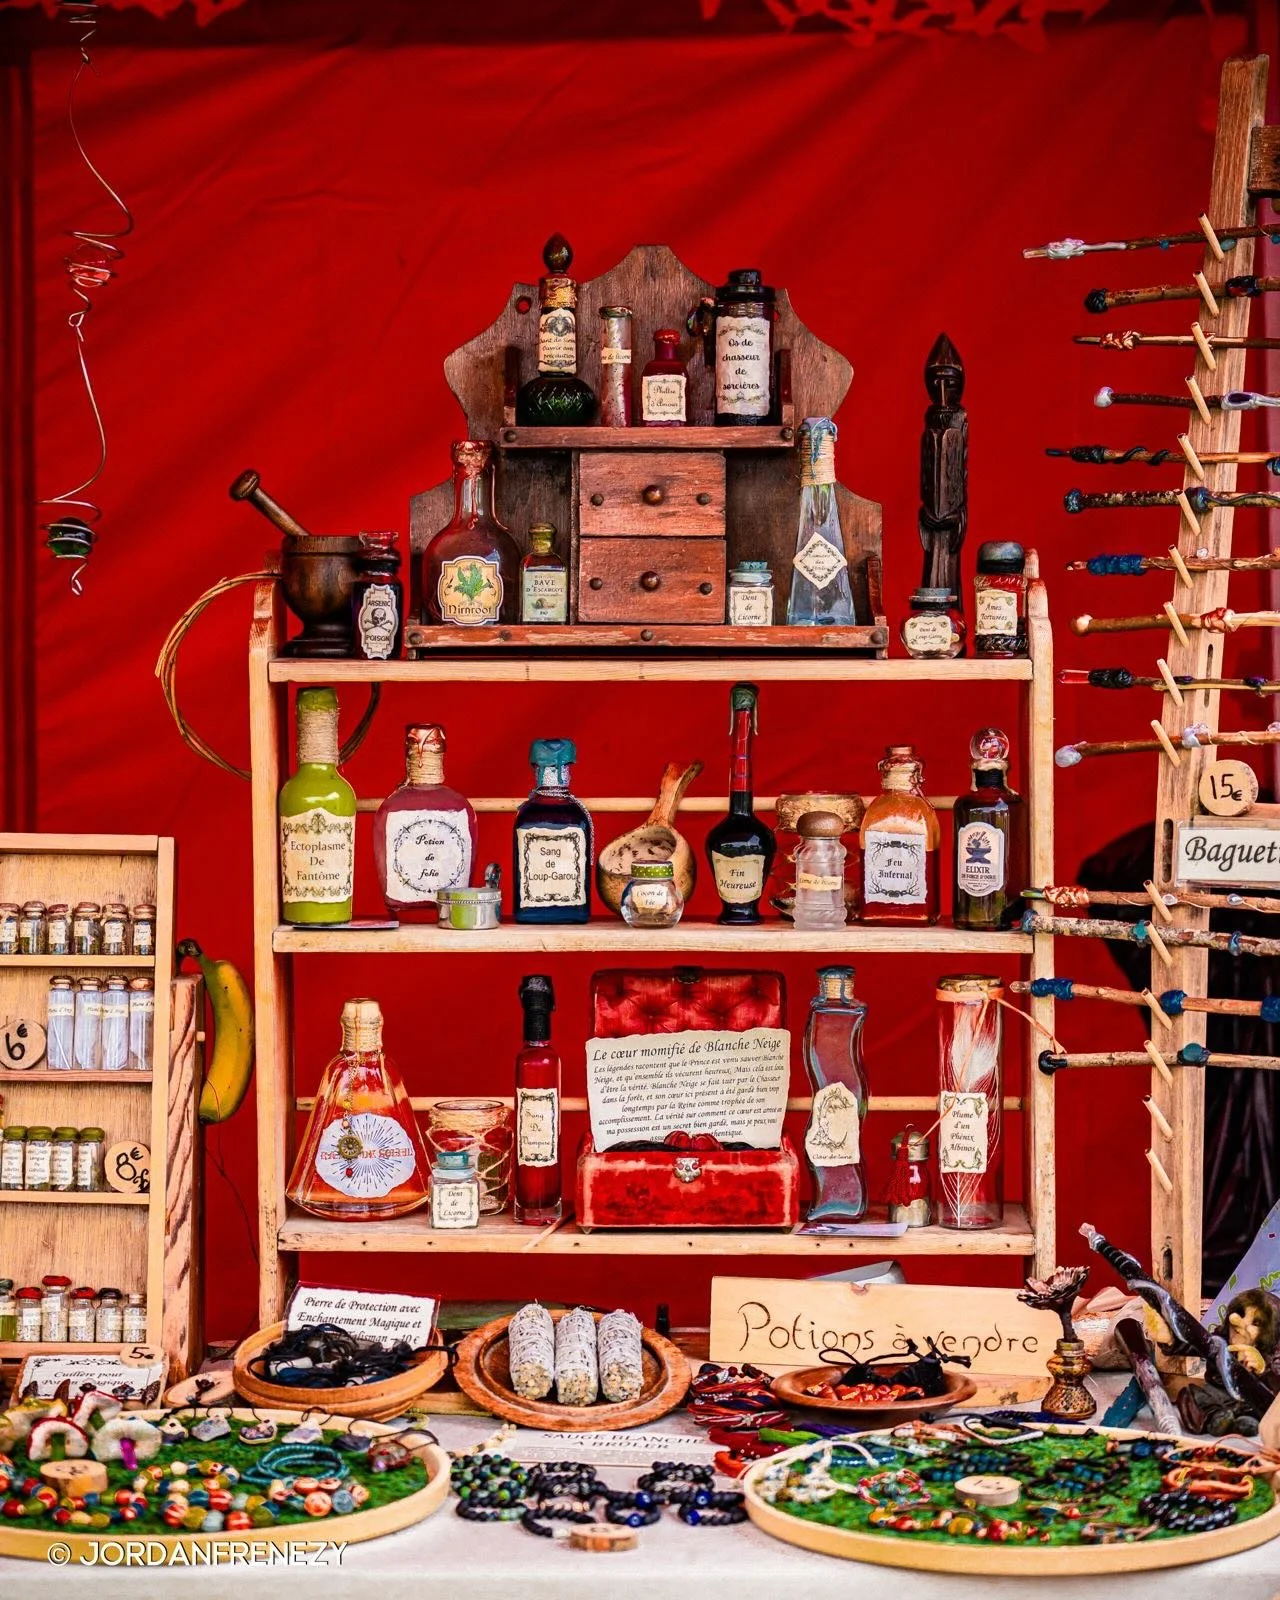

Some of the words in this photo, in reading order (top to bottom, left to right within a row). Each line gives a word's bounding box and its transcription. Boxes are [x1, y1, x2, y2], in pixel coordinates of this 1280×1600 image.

[1210, 774, 1242, 800] 15€
[415, 834, 445, 846] Potion
[290, 841, 346, 854] Ectoplasme
[540, 847, 561, 858] Sang
[1185, 836, 1280, 872] Baguet
[310, 856, 325, 866] De
[546, 860, 556, 868] de
[884, 858, 902, 867] Feu
[296, 871, 340, 881] Fantôme
[418, 869, 440, 880] folie
[529, 872, 577, 882] Loup-Garou
[878, 869, 913, 880] Infernal
[719, 879, 757, 890] Heureuse
[593, 1050, 607, 1060] Le
[611, 1048, 638, 1058] cœur
[641, 1042, 685, 1059] momifié
[689, 1041, 701, 1054] de
[704, 1038, 750, 1052] Blanche
[753, 1037, 781, 1052] Neige
[607, 1064, 634, 1073] légendes
[674, 1070, 702, 1078] vécurent
[752, 1064, 764, 1072] cela
[651, 1081, 677, 1089] Blanche
[679, 1080, 698, 1089] Neige
[707, 1078, 720, 1088] fait
[694, 1089, 718, 1099] présent
[737, 1086, 754, 1095] gardé
[622, 1104, 654, 1113] longtemps
[698, 1110, 726, 1118] comment
[952, 1110, 974, 1119] Plume
[954, 1121, 970, 1130] d'un
[617, 1127, 649, 1136] possession
[950, 1132, 975, 1142] Phénix
[949, 1143, 976, 1152] Albinos
[304, 1296, 333, 1309] Pierre
[335, 1298, 346, 1309] de
[349, 1301, 398, 1313] Protection
[399, 1305, 420, 1313] avec
[296, 1312, 367, 1326] Enchantement
[370, 1317, 409, 1331] Magique
[412, 1320, 422, 1329] et
[737, 1301, 875, 1356] Potions
[892, 1323, 911, 1351] à
[926, 1323, 1039, 1359] vendre
[348, 1330, 388, 1343] Talisman
[400, 1334, 412, 1342] 10
[413, 1336, 419, 1344] €
